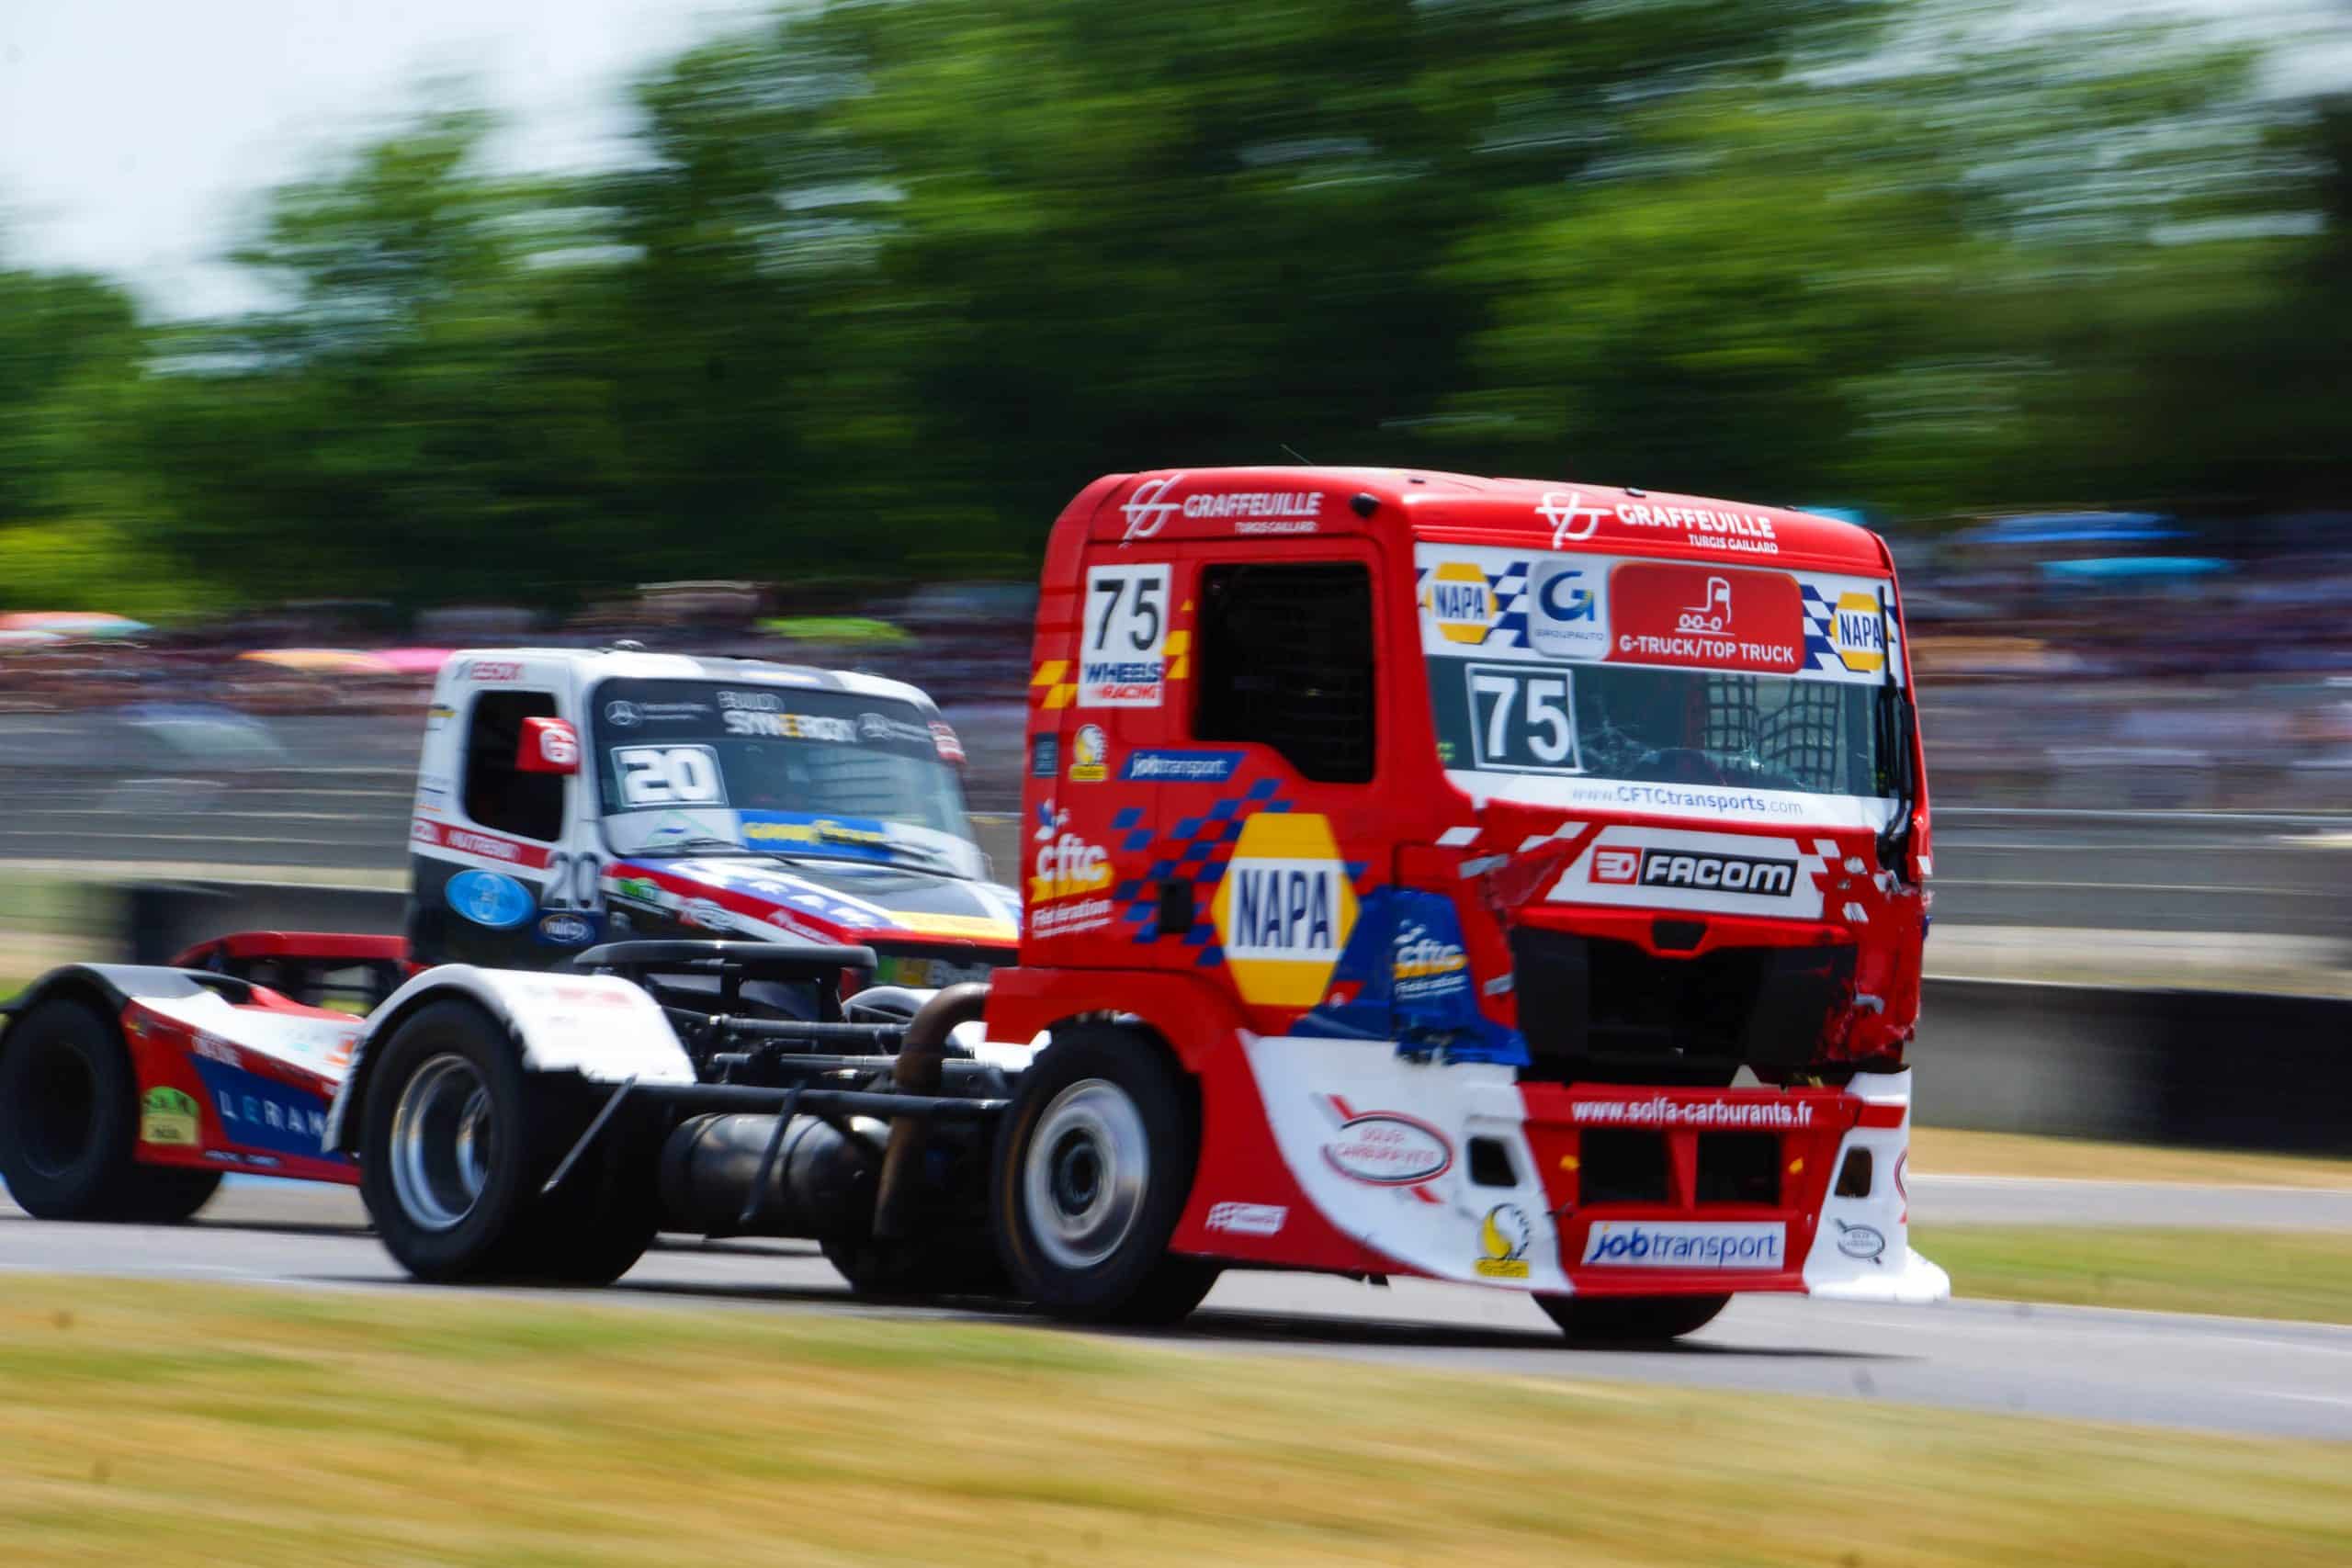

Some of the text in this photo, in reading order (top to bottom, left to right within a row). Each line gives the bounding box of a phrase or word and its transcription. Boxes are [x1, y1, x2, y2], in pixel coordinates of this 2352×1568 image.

[1183, 492, 1323, 517] GRAFFEUILLE
[1616, 502, 1776, 538] GRAFFEUILLE
[1688, 534, 1779, 554] TURGIS GAILLARD
[1094, 579, 1160, 650] 75
[1433, 582, 1487, 620] NAPA
[1620, 635, 1794, 663] G-TRUCK/TOP TRUCK
[1840, 614, 1883, 649] NAPA
[1086, 662, 1163, 682] WHEELS
[1474, 675, 1570, 761] 75
[619, 747, 718, 804] 20
[1573, 786, 1803, 815] www.CFTCtransports.com
[1036, 833, 1108, 882] cftc
[1645, 854, 1792, 891] FACOM
[542, 851, 603, 909] 20
[1235, 868, 1332, 950] NAPA
[1396, 939, 1464, 967] cftc
[1572, 1098, 1813, 1125] www.solfa-carburants.fr
[1589, 1223, 1780, 1269] jobtransport
